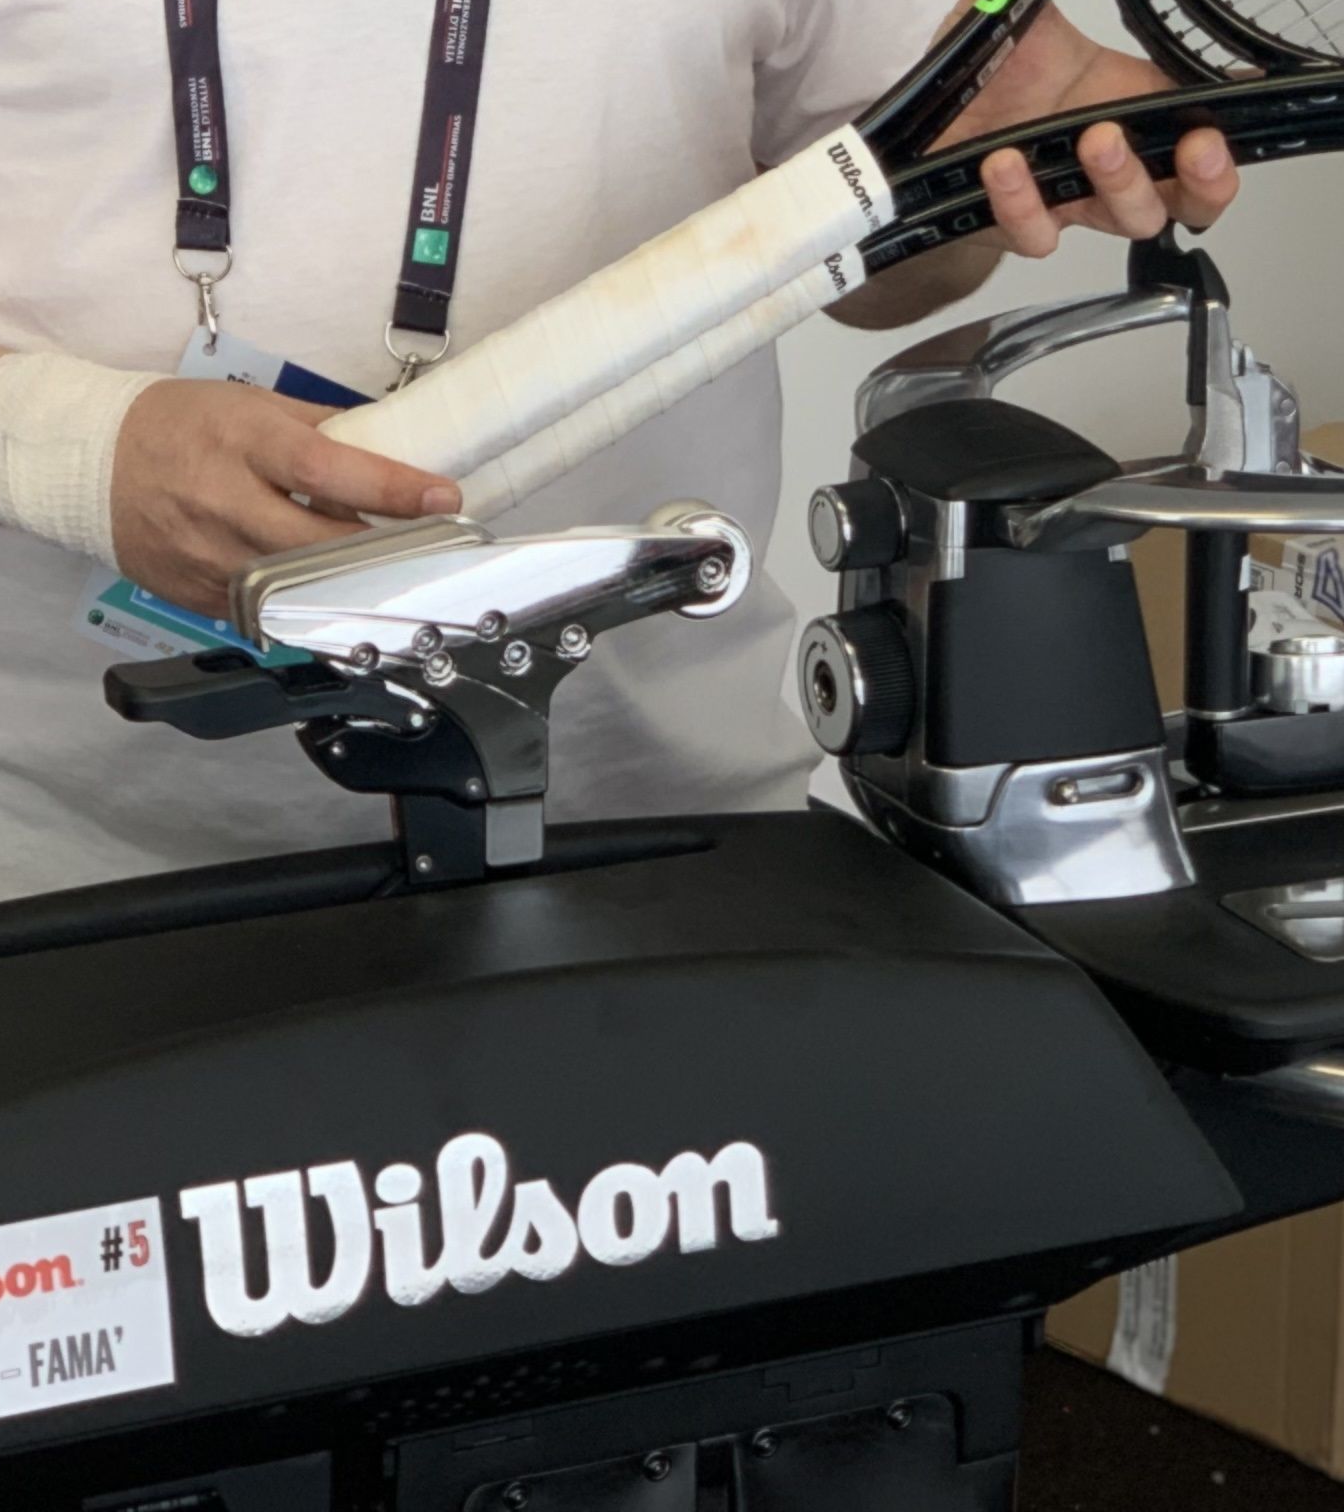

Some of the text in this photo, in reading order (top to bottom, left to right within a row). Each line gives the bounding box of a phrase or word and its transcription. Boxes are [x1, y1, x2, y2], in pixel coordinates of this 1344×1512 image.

[188, 77, 202, 161] INTERNAZIONALI
[201, 128, 213, 161] BNL
[420, 182, 439, 223] BNL
[827, 141, 874, 215] Wilson
[824, 252, 847, 291] lson
[100, 1220, 151, 1273] #5
[179, 1132, 780, 1337] Wilson
